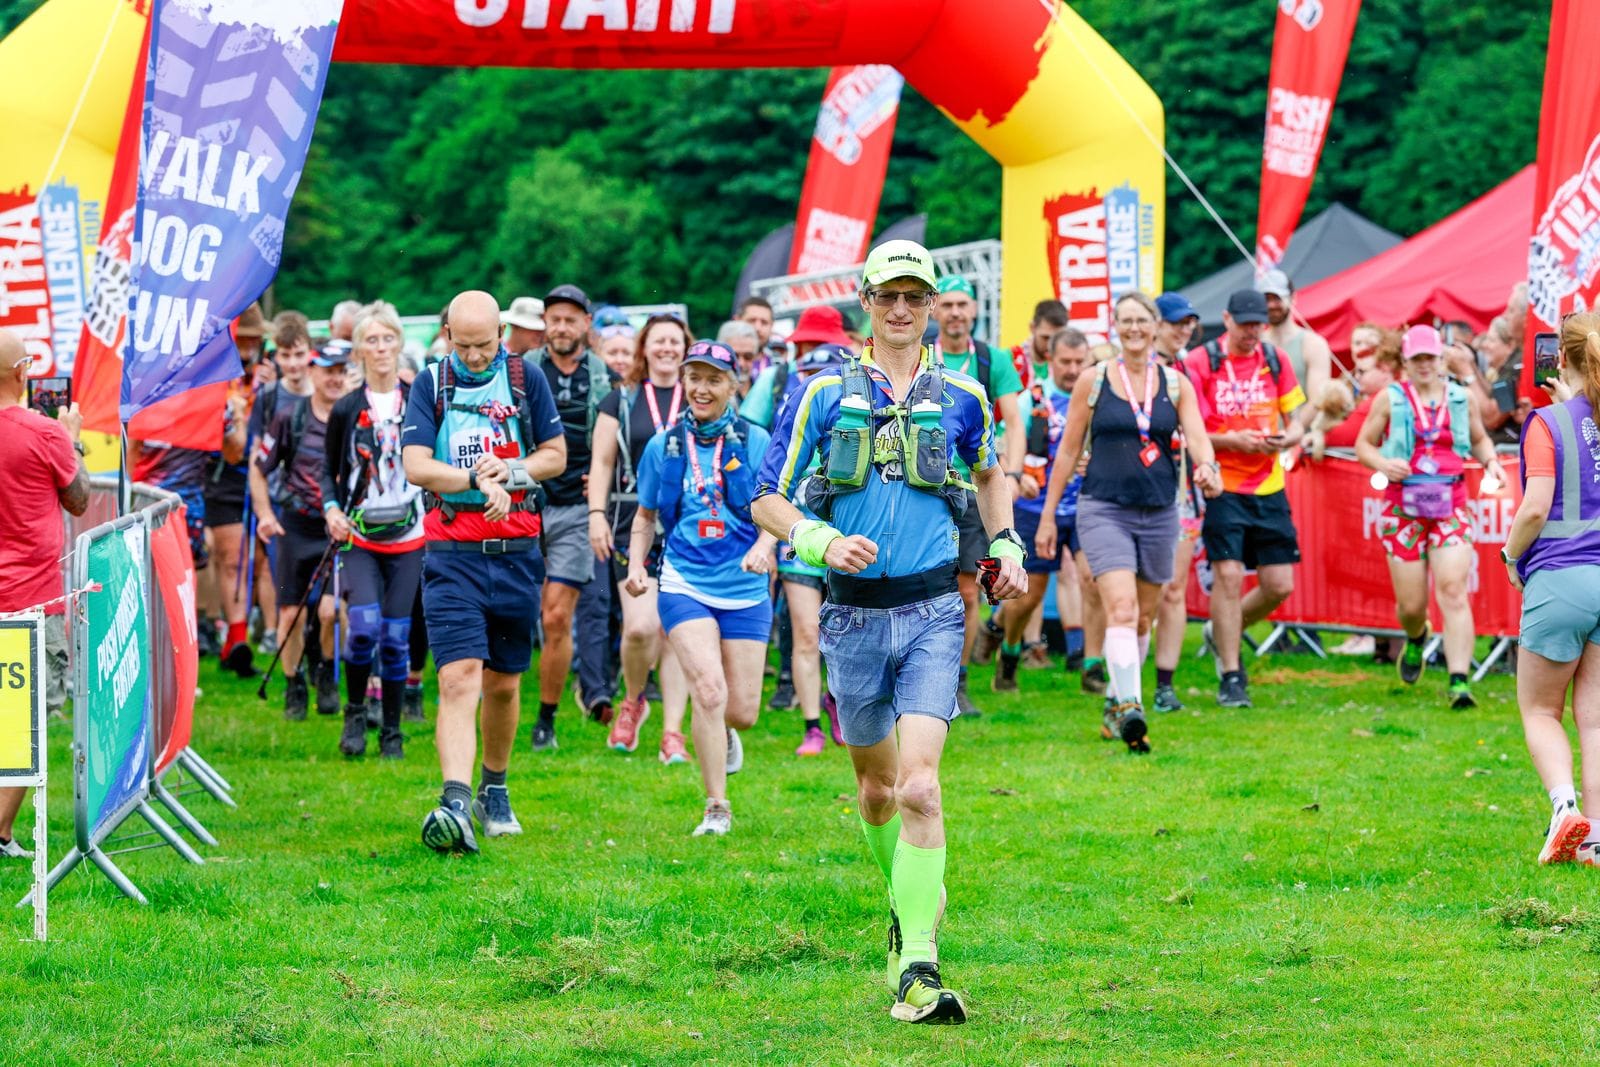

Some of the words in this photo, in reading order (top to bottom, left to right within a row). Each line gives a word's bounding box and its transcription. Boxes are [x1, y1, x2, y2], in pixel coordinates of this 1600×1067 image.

[42, 201, 82, 372] CHALLENGE
[888, 253, 921, 264] IRONMAN
[134, 291, 209, 356] UN
